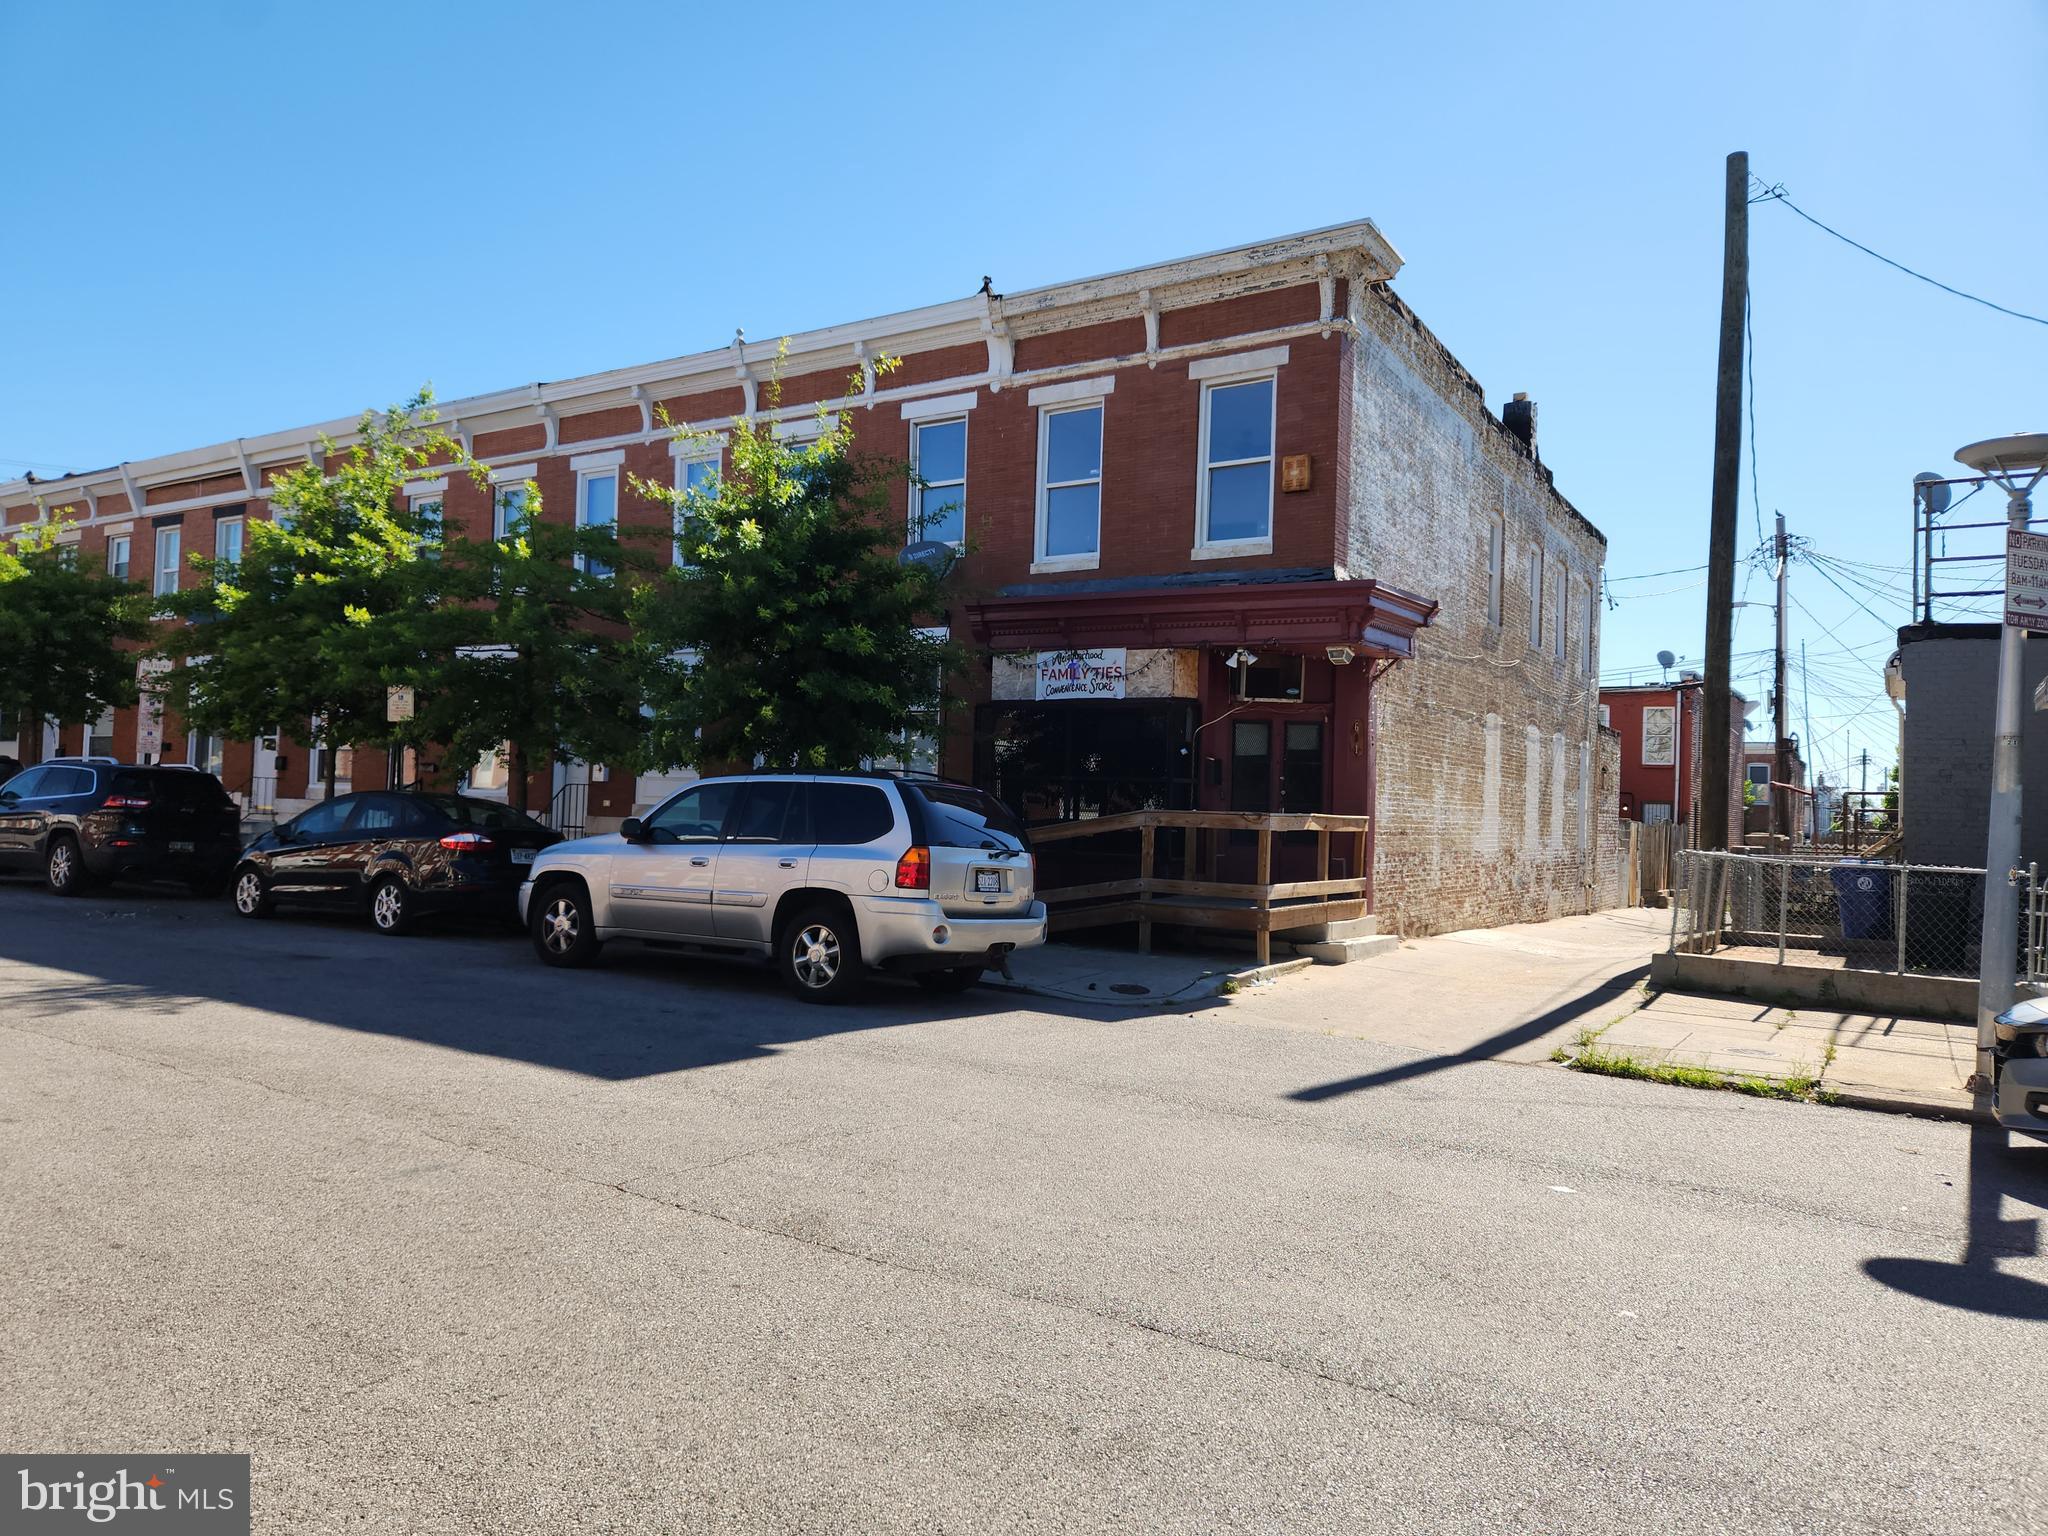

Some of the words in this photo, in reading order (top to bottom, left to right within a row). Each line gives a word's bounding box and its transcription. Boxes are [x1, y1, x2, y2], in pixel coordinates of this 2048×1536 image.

[2009, 532, 2020, 548] NO
[2021, 535, 2048, 551] PARKIN
[913, 548, 936, 559] DIRECTV
[2013, 554, 2048, 570] TUESDAY
[2007, 614, 2019, 626] TOW
[2020, 616, 2035, 628] AWAY
[2036, 618, 2048, 630] ZON
[1041, 667, 1090, 681] FAMILY
[1091, 666, 1122, 680] TIES
